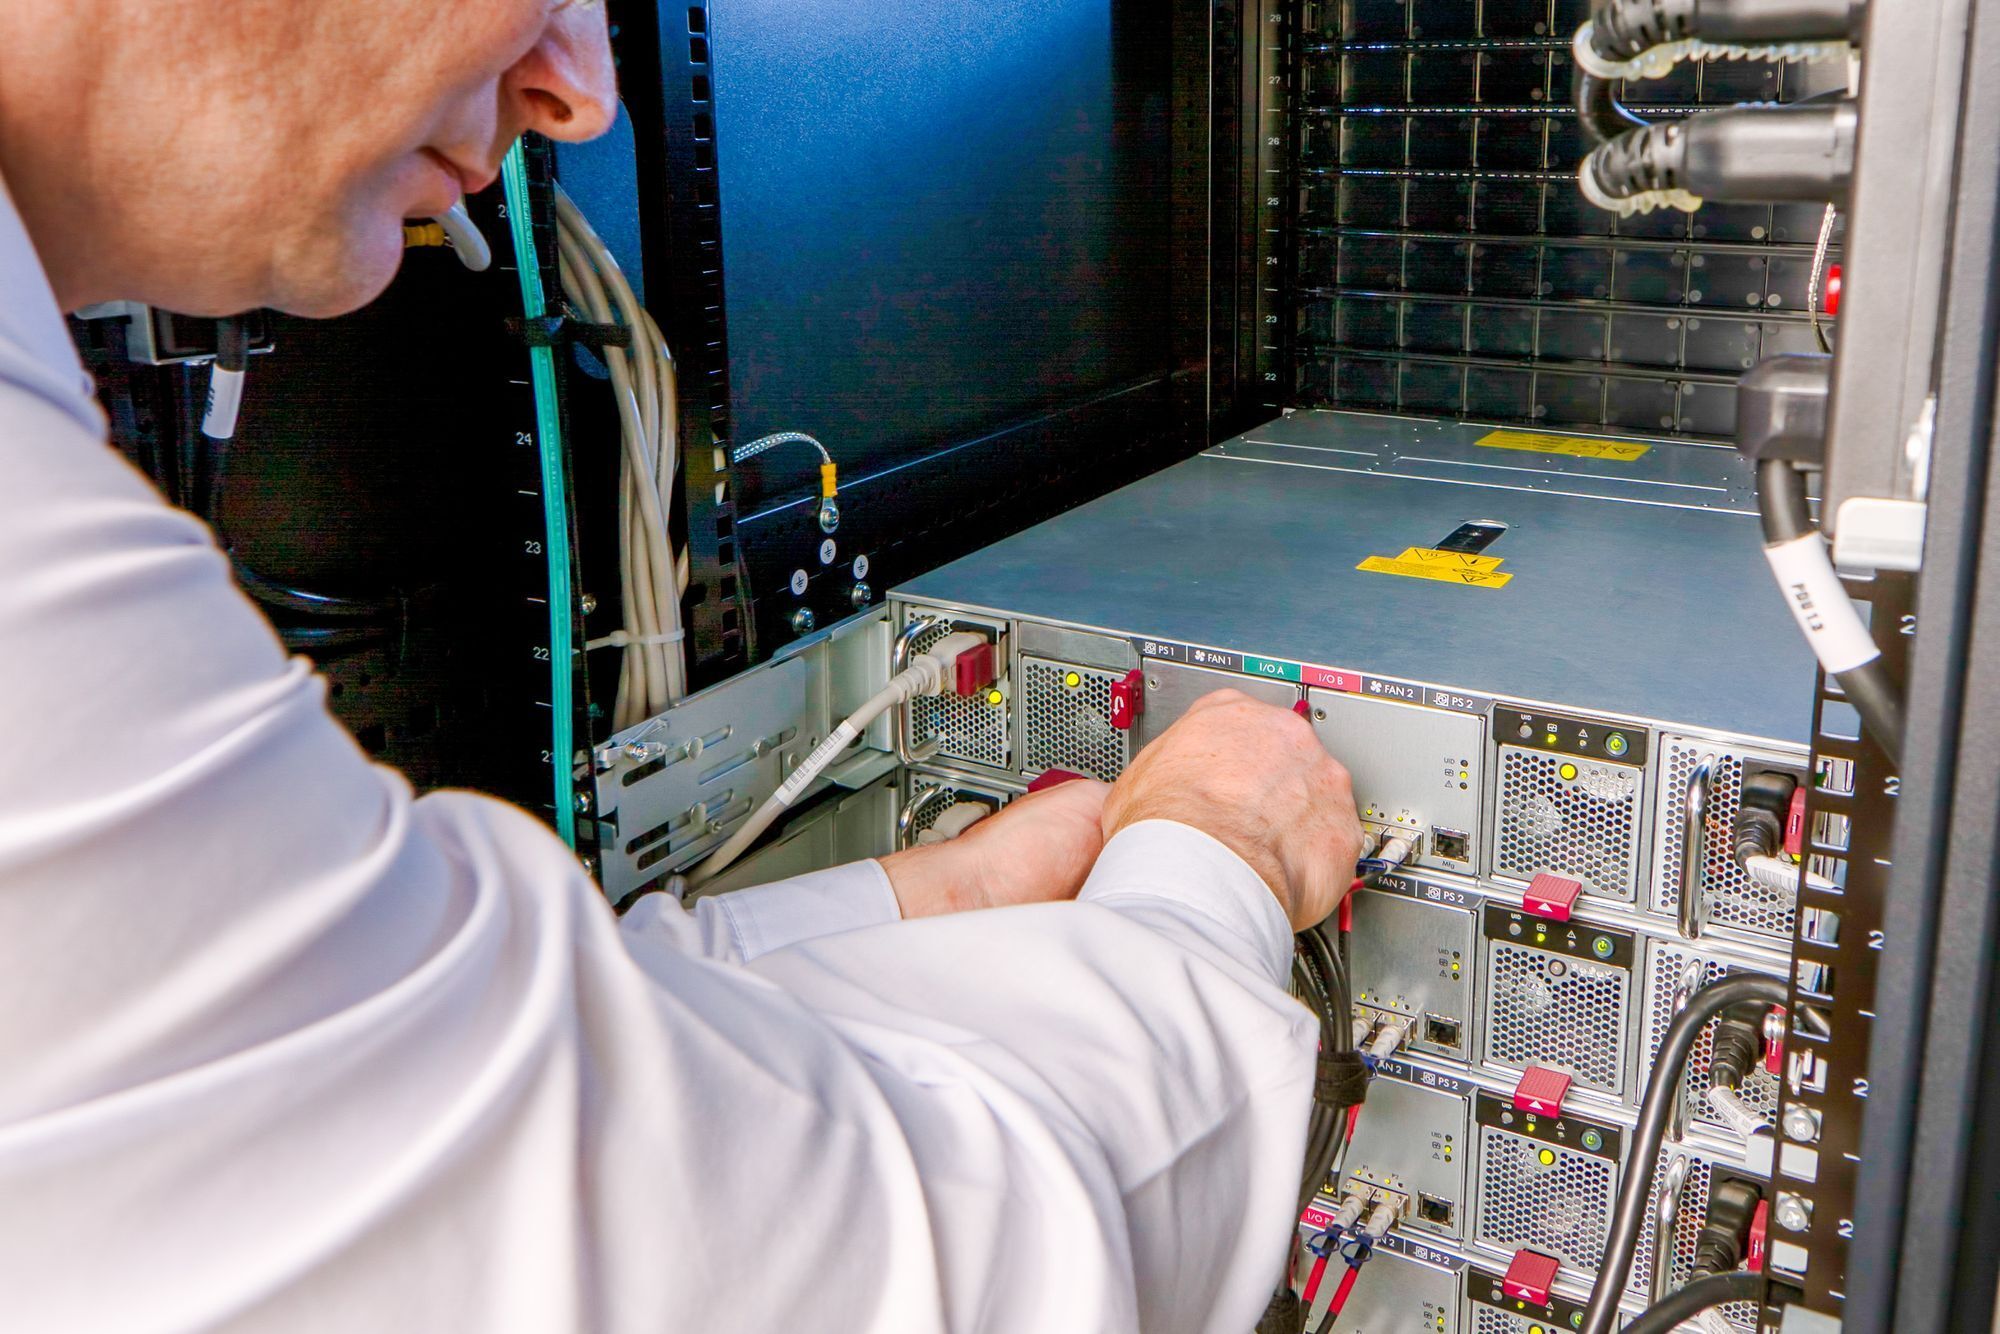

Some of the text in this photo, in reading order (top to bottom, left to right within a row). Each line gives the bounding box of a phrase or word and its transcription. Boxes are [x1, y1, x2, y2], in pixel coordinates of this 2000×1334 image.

[1269, 76, 1280, 84] 27
[1268, 137, 1280, 145] 26
[1267, 197, 1279, 205] 25
[498, 204, 511, 218] 2
[1266, 257, 1278, 265] 24
[1266, 315, 1278, 323] 23
[1265, 373, 1277, 381] 22
[516, 431, 532, 446] 24
[525, 540, 541, 554] 23
[533, 646, 550, 661] 22
[1158, 646, 1174, 656] PS 1
[1208, 654, 1232, 665] FAN 1
[1259, 663, 1285, 675] I/O A
[1318, 673, 1344, 686] I/O B
[1384, 684, 1414, 699] FAN 2
[1451, 697, 1473, 709] PS 2
[1443, 757, 1455, 765] UID
[1378, 877, 1407, 890] FAN 2
[1443, 891, 1464, 904] PS 2
[1395, 1066, 1402, 1075] 2
[1438, 1077, 1459, 1090] PS 2
[1307, 1212, 1323, 1223] I/O
[1430, 1251, 1450, 1265] PS 2
